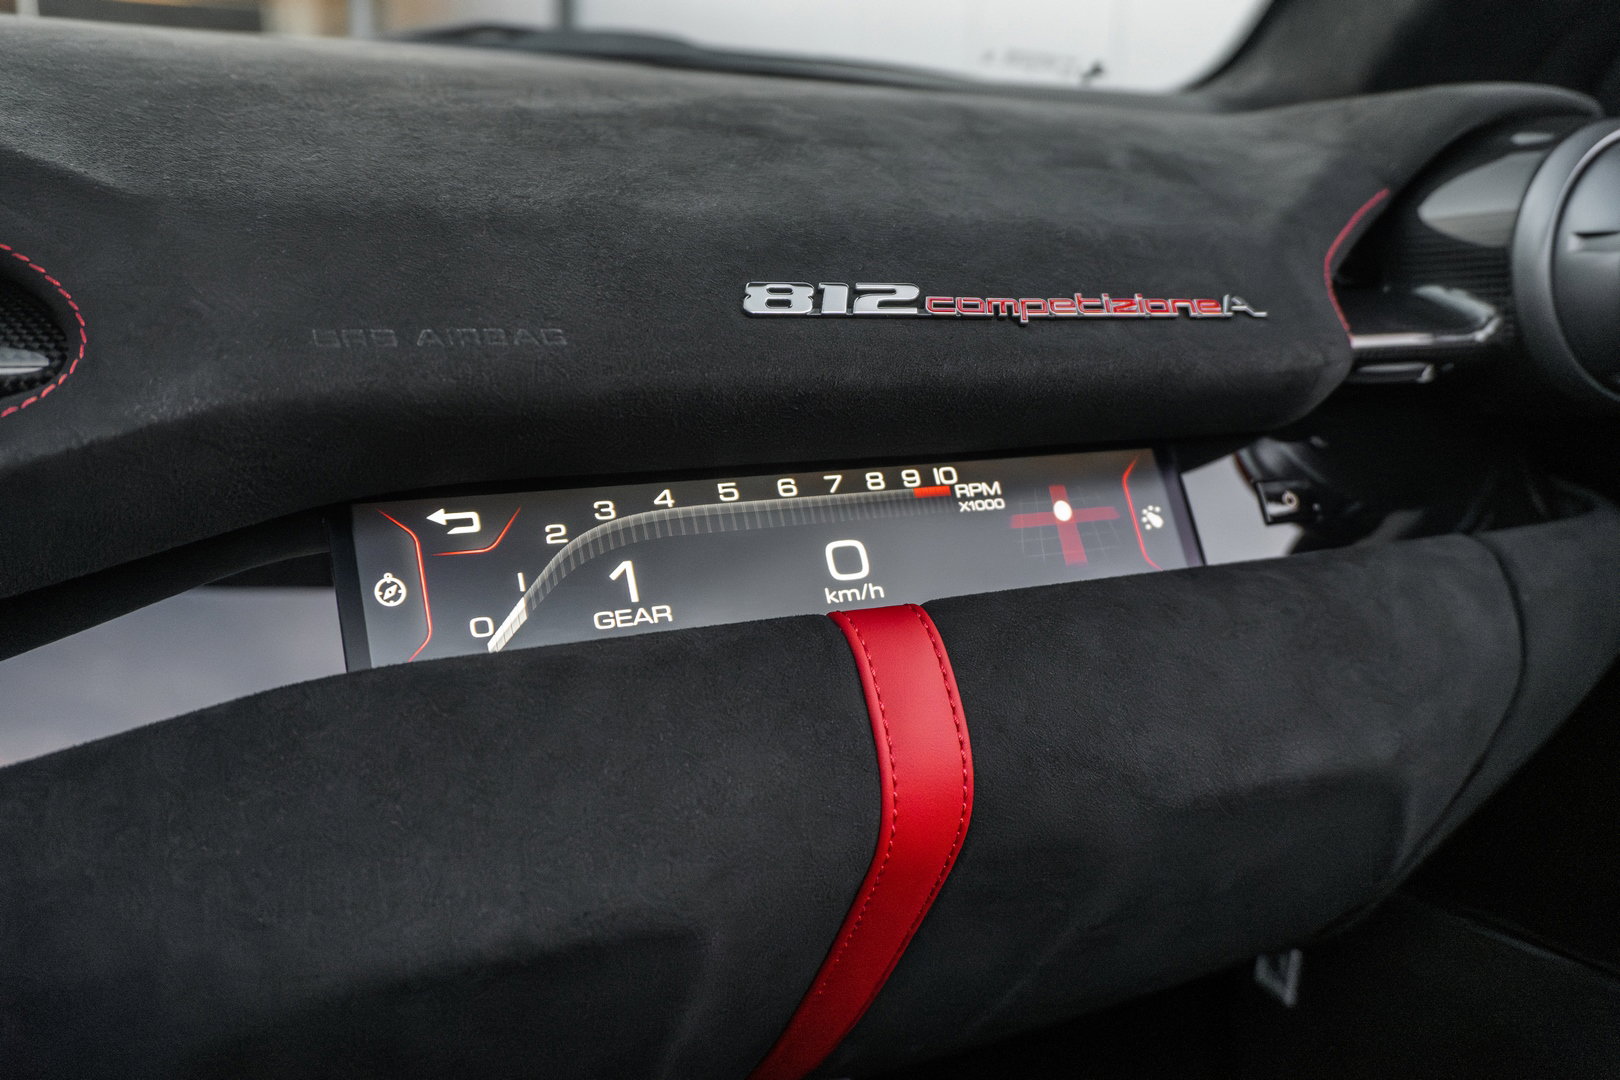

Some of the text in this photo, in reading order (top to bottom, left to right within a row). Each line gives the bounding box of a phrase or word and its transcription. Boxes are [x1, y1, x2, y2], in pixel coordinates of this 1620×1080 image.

[743, 281, 921, 317] 812
[416, 328, 569, 347] AIRBAG
[954, 480, 1002, 499] RPM
[470, 616, 495, 639] 0
[545, 523, 569, 545] 2
[593, 500, 617, 521] 3
[653, 489, 675, 508] 4
[717, 482, 740, 502] 5
[776, 478, 799, 498] 6
[823, 475, 843, 494] 7
[865, 472, 886, 491] 8
[901, 469, 921, 488] 9
[933, 466, 959, 486] 10
[824, 539, 870, 582] 0
[608, 560, 641, 603] 1
[824, 583, 885, 605] km/h
[593, 604, 674, 631] GEAR
